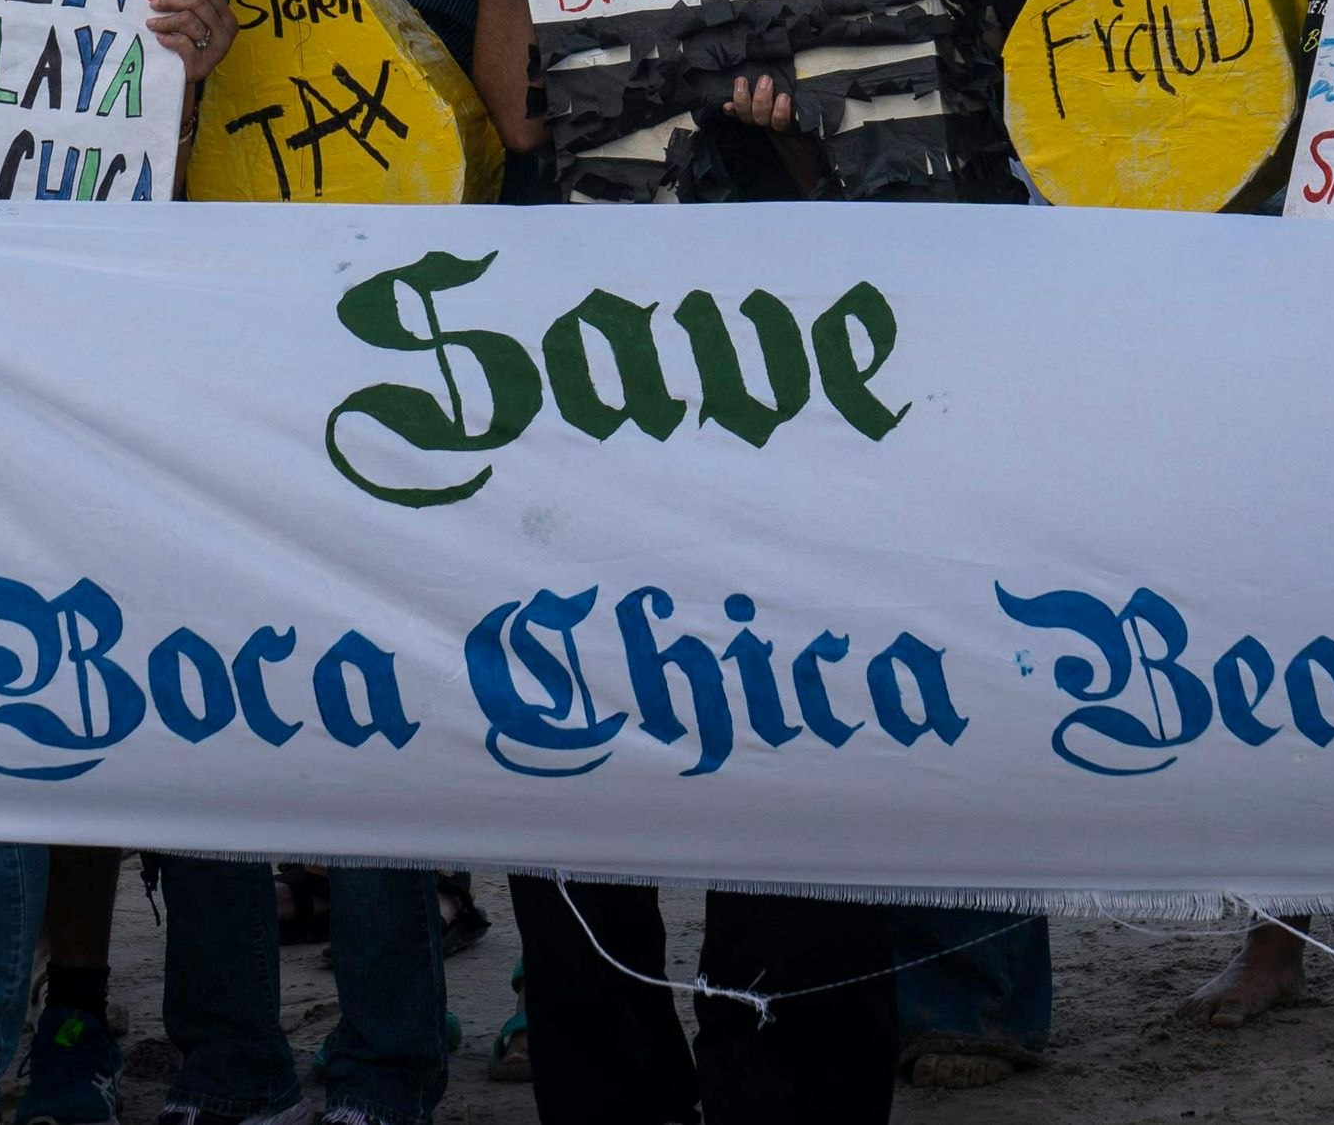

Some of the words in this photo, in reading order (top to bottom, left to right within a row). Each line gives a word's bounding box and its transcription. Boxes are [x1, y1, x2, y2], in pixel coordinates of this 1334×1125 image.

[225, 59, 409, 202] TAX
[324, 249, 913, 509] Save
[465, 584, 969, 777] Chica
